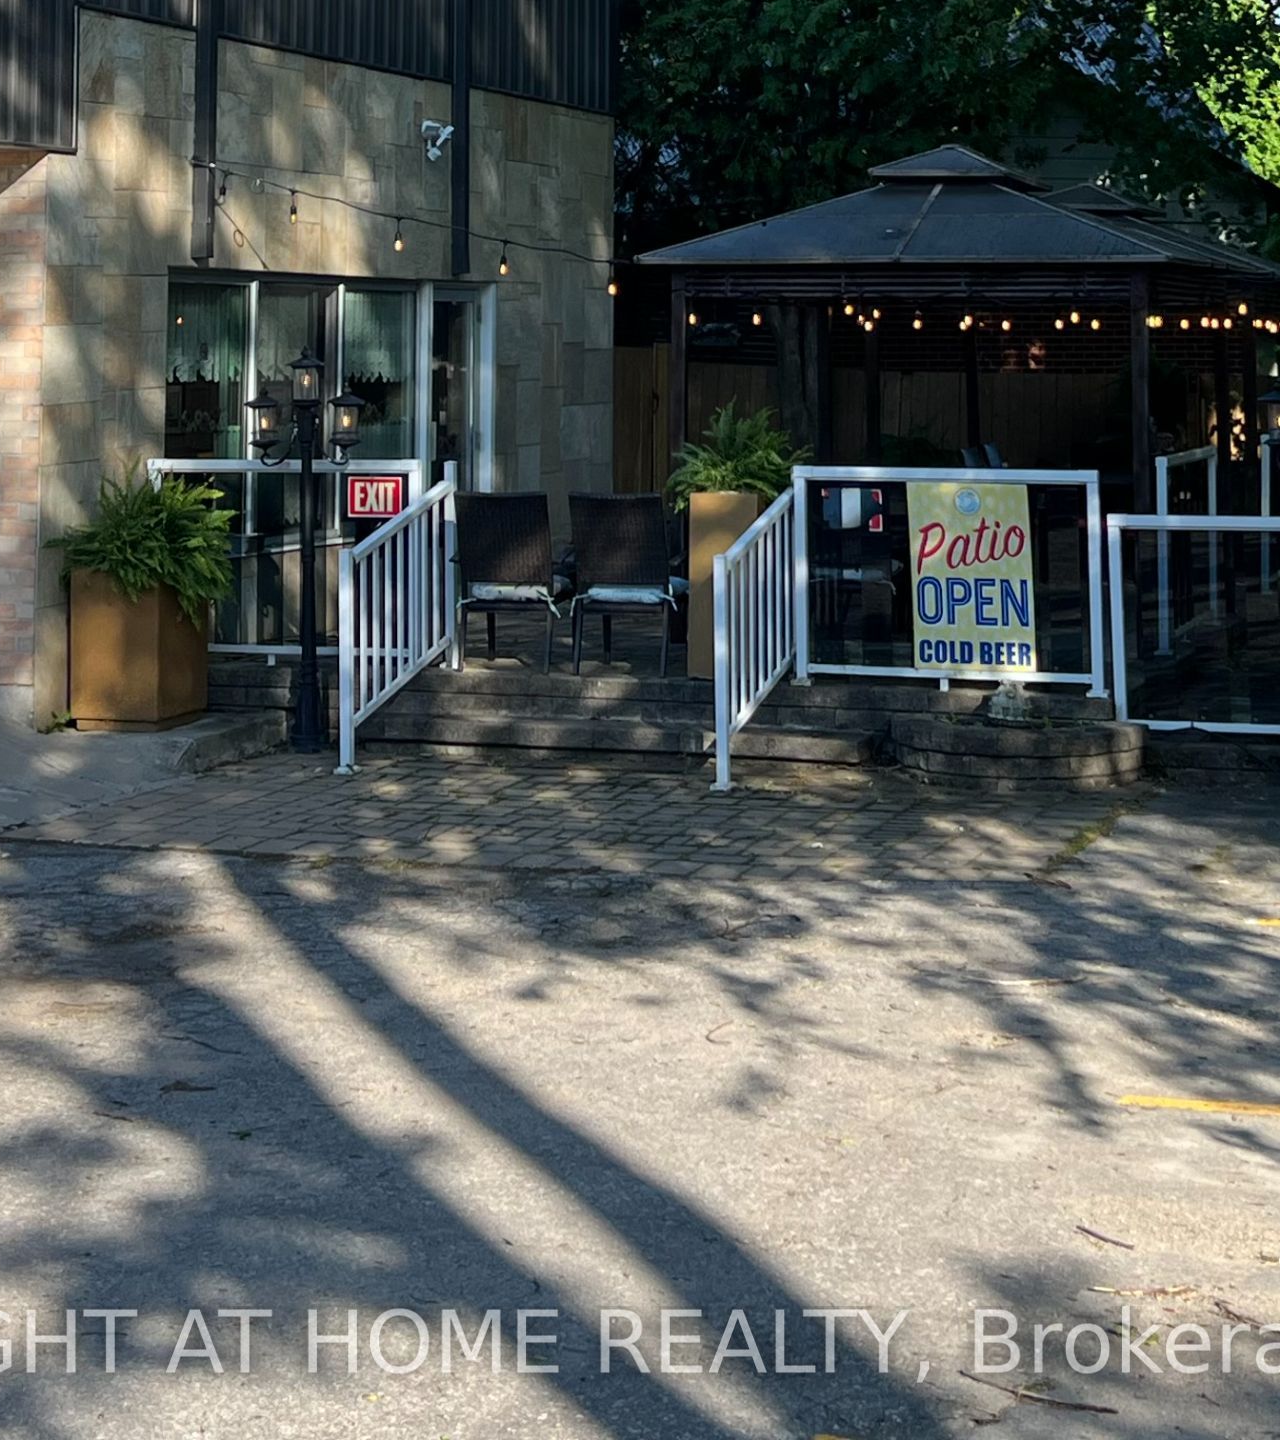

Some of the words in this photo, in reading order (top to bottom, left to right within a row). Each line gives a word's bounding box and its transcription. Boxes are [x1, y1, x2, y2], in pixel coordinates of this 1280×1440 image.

[354, 481, 396, 512] EXIT
[917, 517, 1025, 575] Patio
[917, 576, 1030, 627] OPEN
[919, 639, 973, 664] COLD
[980, 641, 1032, 666] BEER
